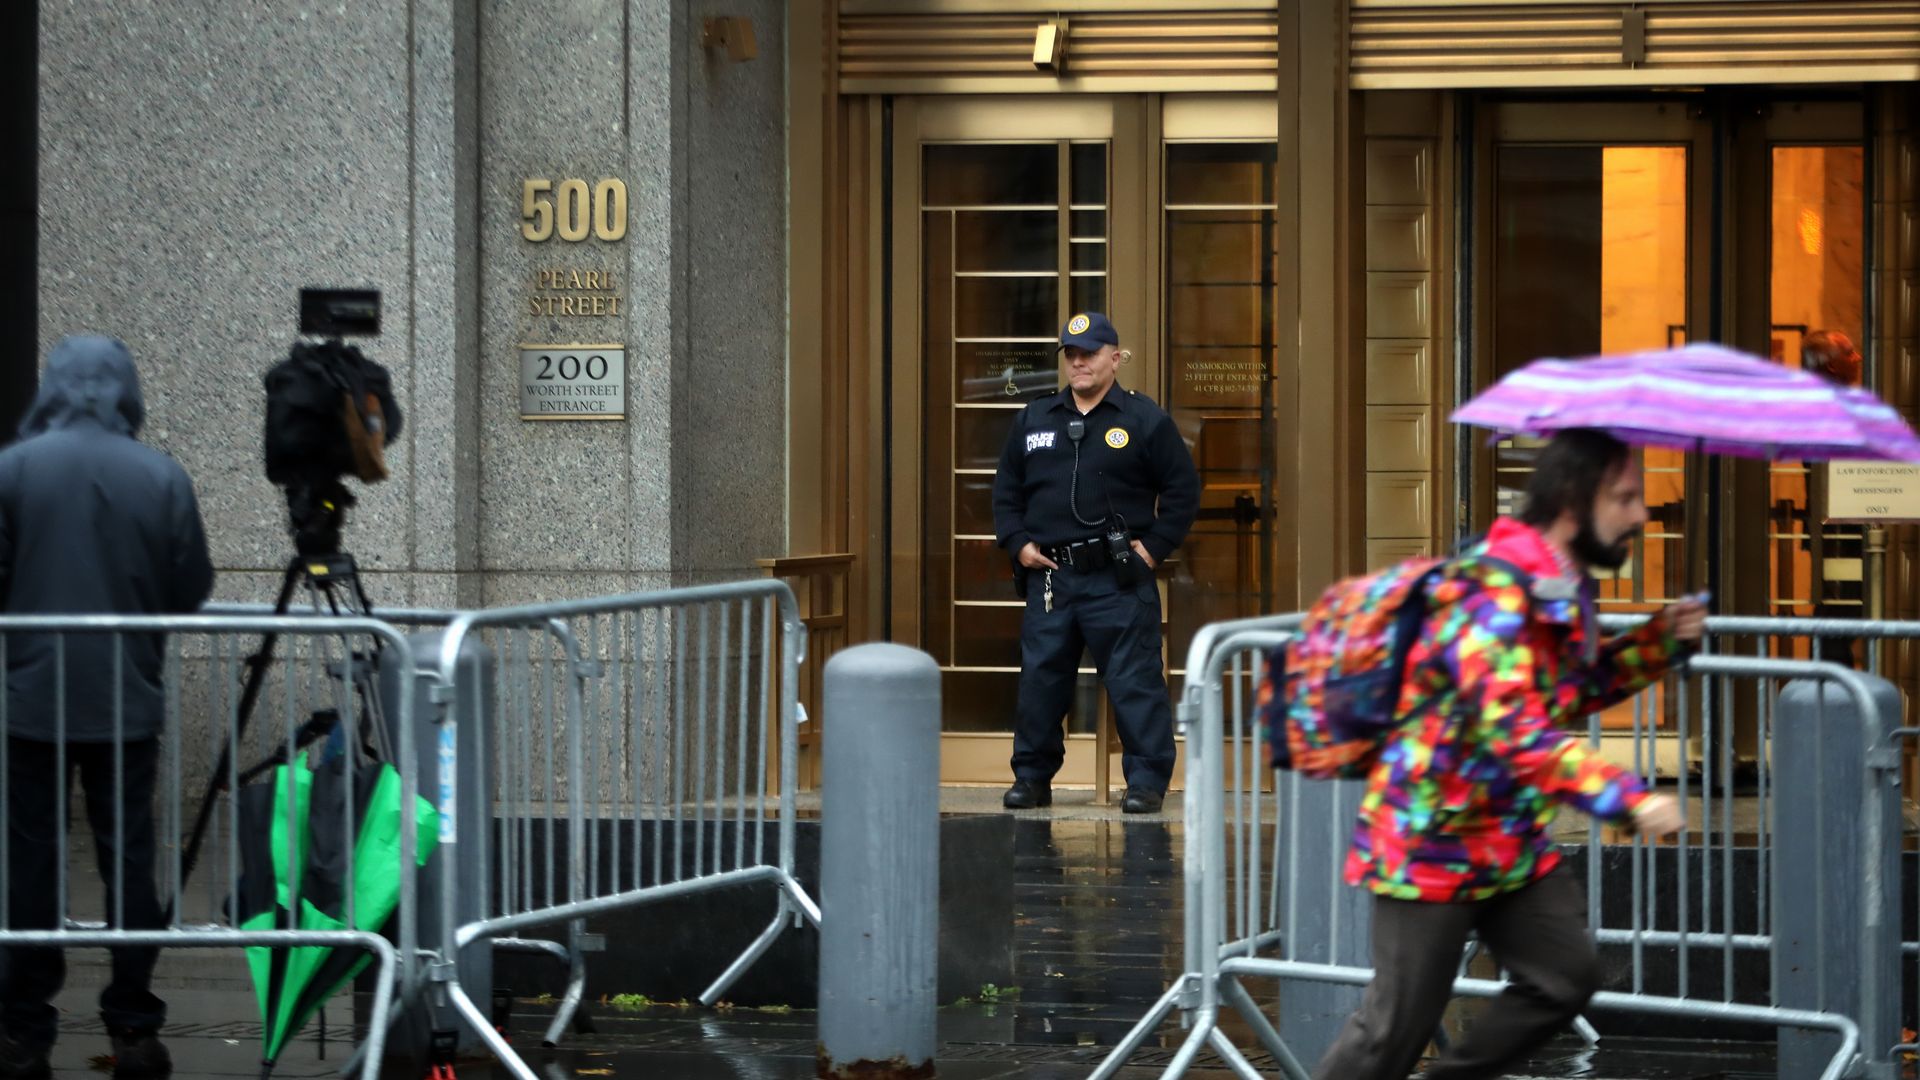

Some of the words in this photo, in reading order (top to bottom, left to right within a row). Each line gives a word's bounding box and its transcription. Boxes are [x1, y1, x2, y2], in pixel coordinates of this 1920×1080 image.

[521, 177, 628, 242] 500
[537, 269, 616, 290] PEARL
[528, 296, 623, 317] STREET
[535, 355, 609, 381] 200
[1186, 362, 1199, 370] NO
[1199, 362, 1236, 370] SMOKING
[1237, 362, 1267, 370] WITHIN
[1185, 373, 1193, 381] 25
[1194, 373, 1213, 381] FEET
[1214, 373, 1225, 381] OF
[1226, 373, 1269, 381] ENTRANCE
[525, 385, 573, 397] WORTH
[574, 385, 619, 397] STREET
[1193, 384, 1202, 392] 41
[539, 400, 607, 412] ENTRANCE
[1026, 431, 1055, 442] POLICE
[1836, 467, 1855, 475] LAW
[1865, 506, 1889, 514] ONLY
